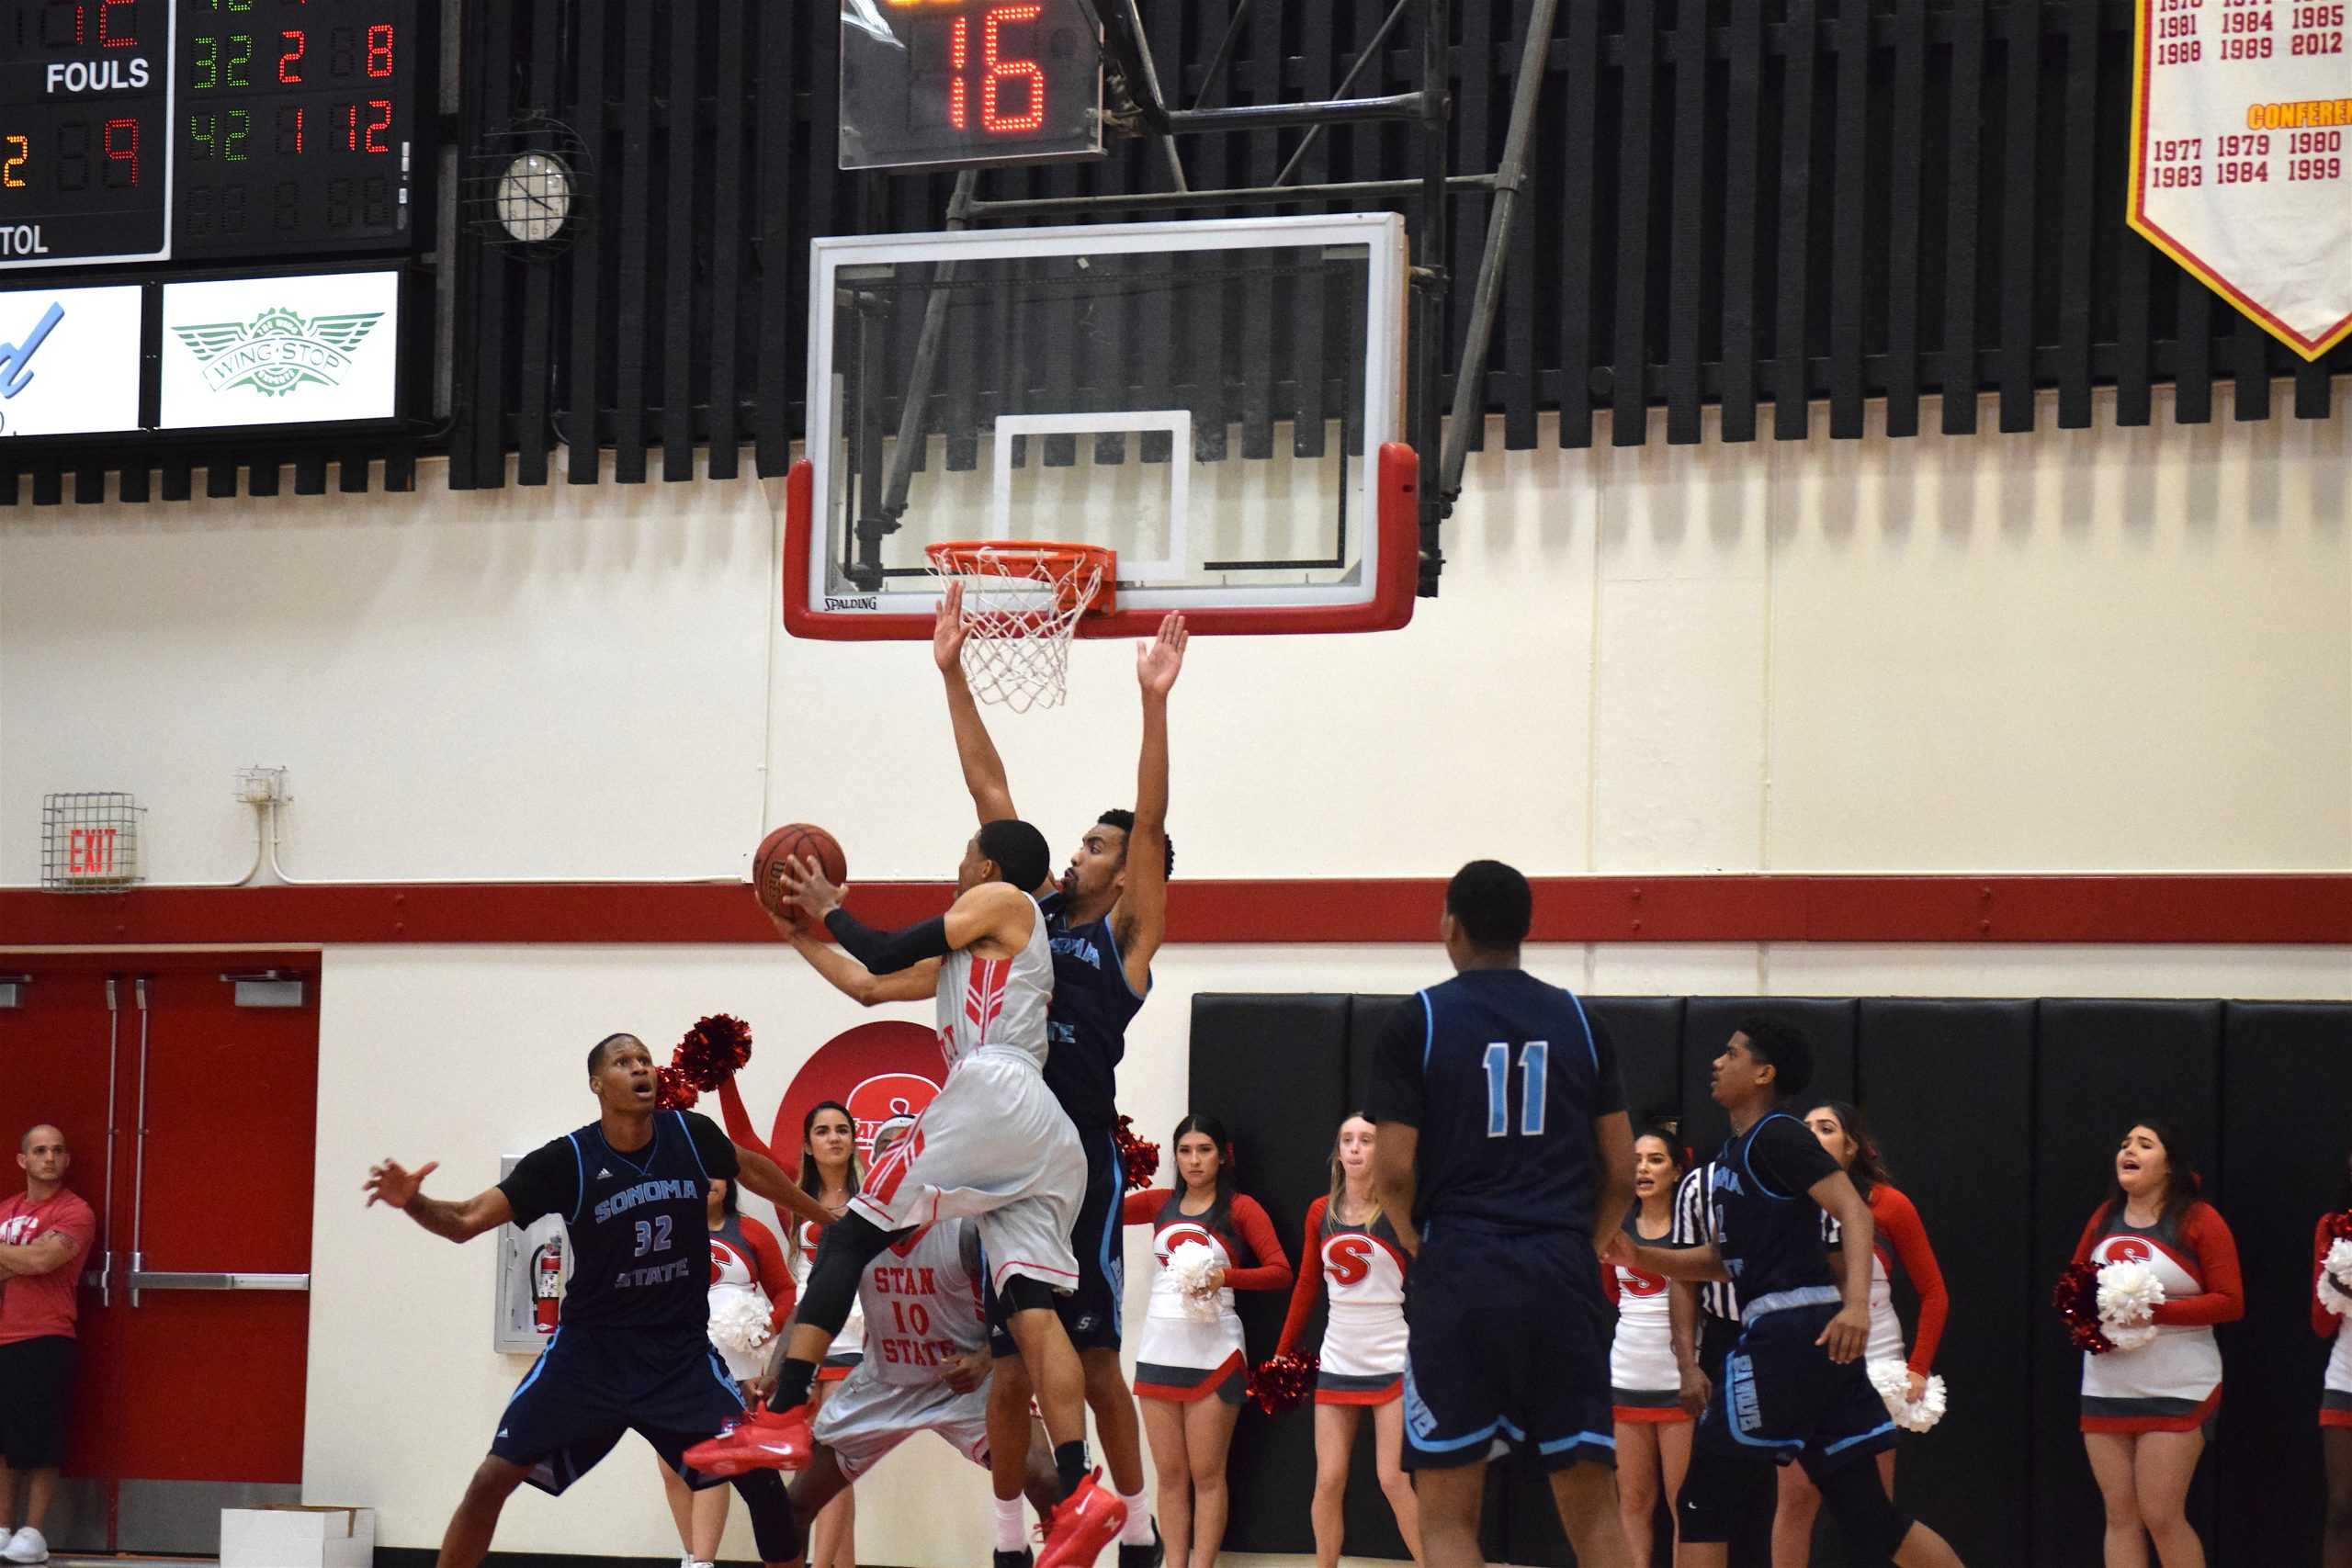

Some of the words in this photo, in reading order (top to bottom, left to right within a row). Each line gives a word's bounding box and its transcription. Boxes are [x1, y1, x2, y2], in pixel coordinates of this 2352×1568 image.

[2159, 14, 2197, 39] 1981
[2222, 10, 2274, 34] 1984
[2292, 5, 2345, 29] 1985
[193, 35, 252, 88] 32
[279, 29, 306, 84] 2
[368, 24, 393, 78] 8
[951, 5, 1044, 131] 16
[2157, 40, 2202, 65] 1988
[2220, 37, 2273, 60] 1989
[2291, 32, 2343, 55] 2012
[47, 58, 149, 93] FOULS
[190, 109, 251, 162] 42
[296, 107, 303, 154] 1
[348, 99, 391, 153] 12
[2154, 139, 2202, 162] 1977
[2217, 134, 2270, 158] 1979
[2289, 130, 2341, 154] 1980
[4, 135, 28, 188] 2
[105, 118, 139, 187] 9
[2153, 165, 2202, 188] 1983
[2217, 161, 2268, 185] 1984
[2289, 158, 2341, 181] 1999
[824, 596, 877, 611] SPALDING
[70, 829, 117, 873] EXIT
[1482, 1040, 1549, 1138] 11
[594, 1179, 698, 1224] SONOMA
[634, 1214, 673, 1258] 32
[614, 1258, 689, 1289] STATE
[874, 1267, 936, 1296] STAN
[891, 1301, 930, 1337] 10
